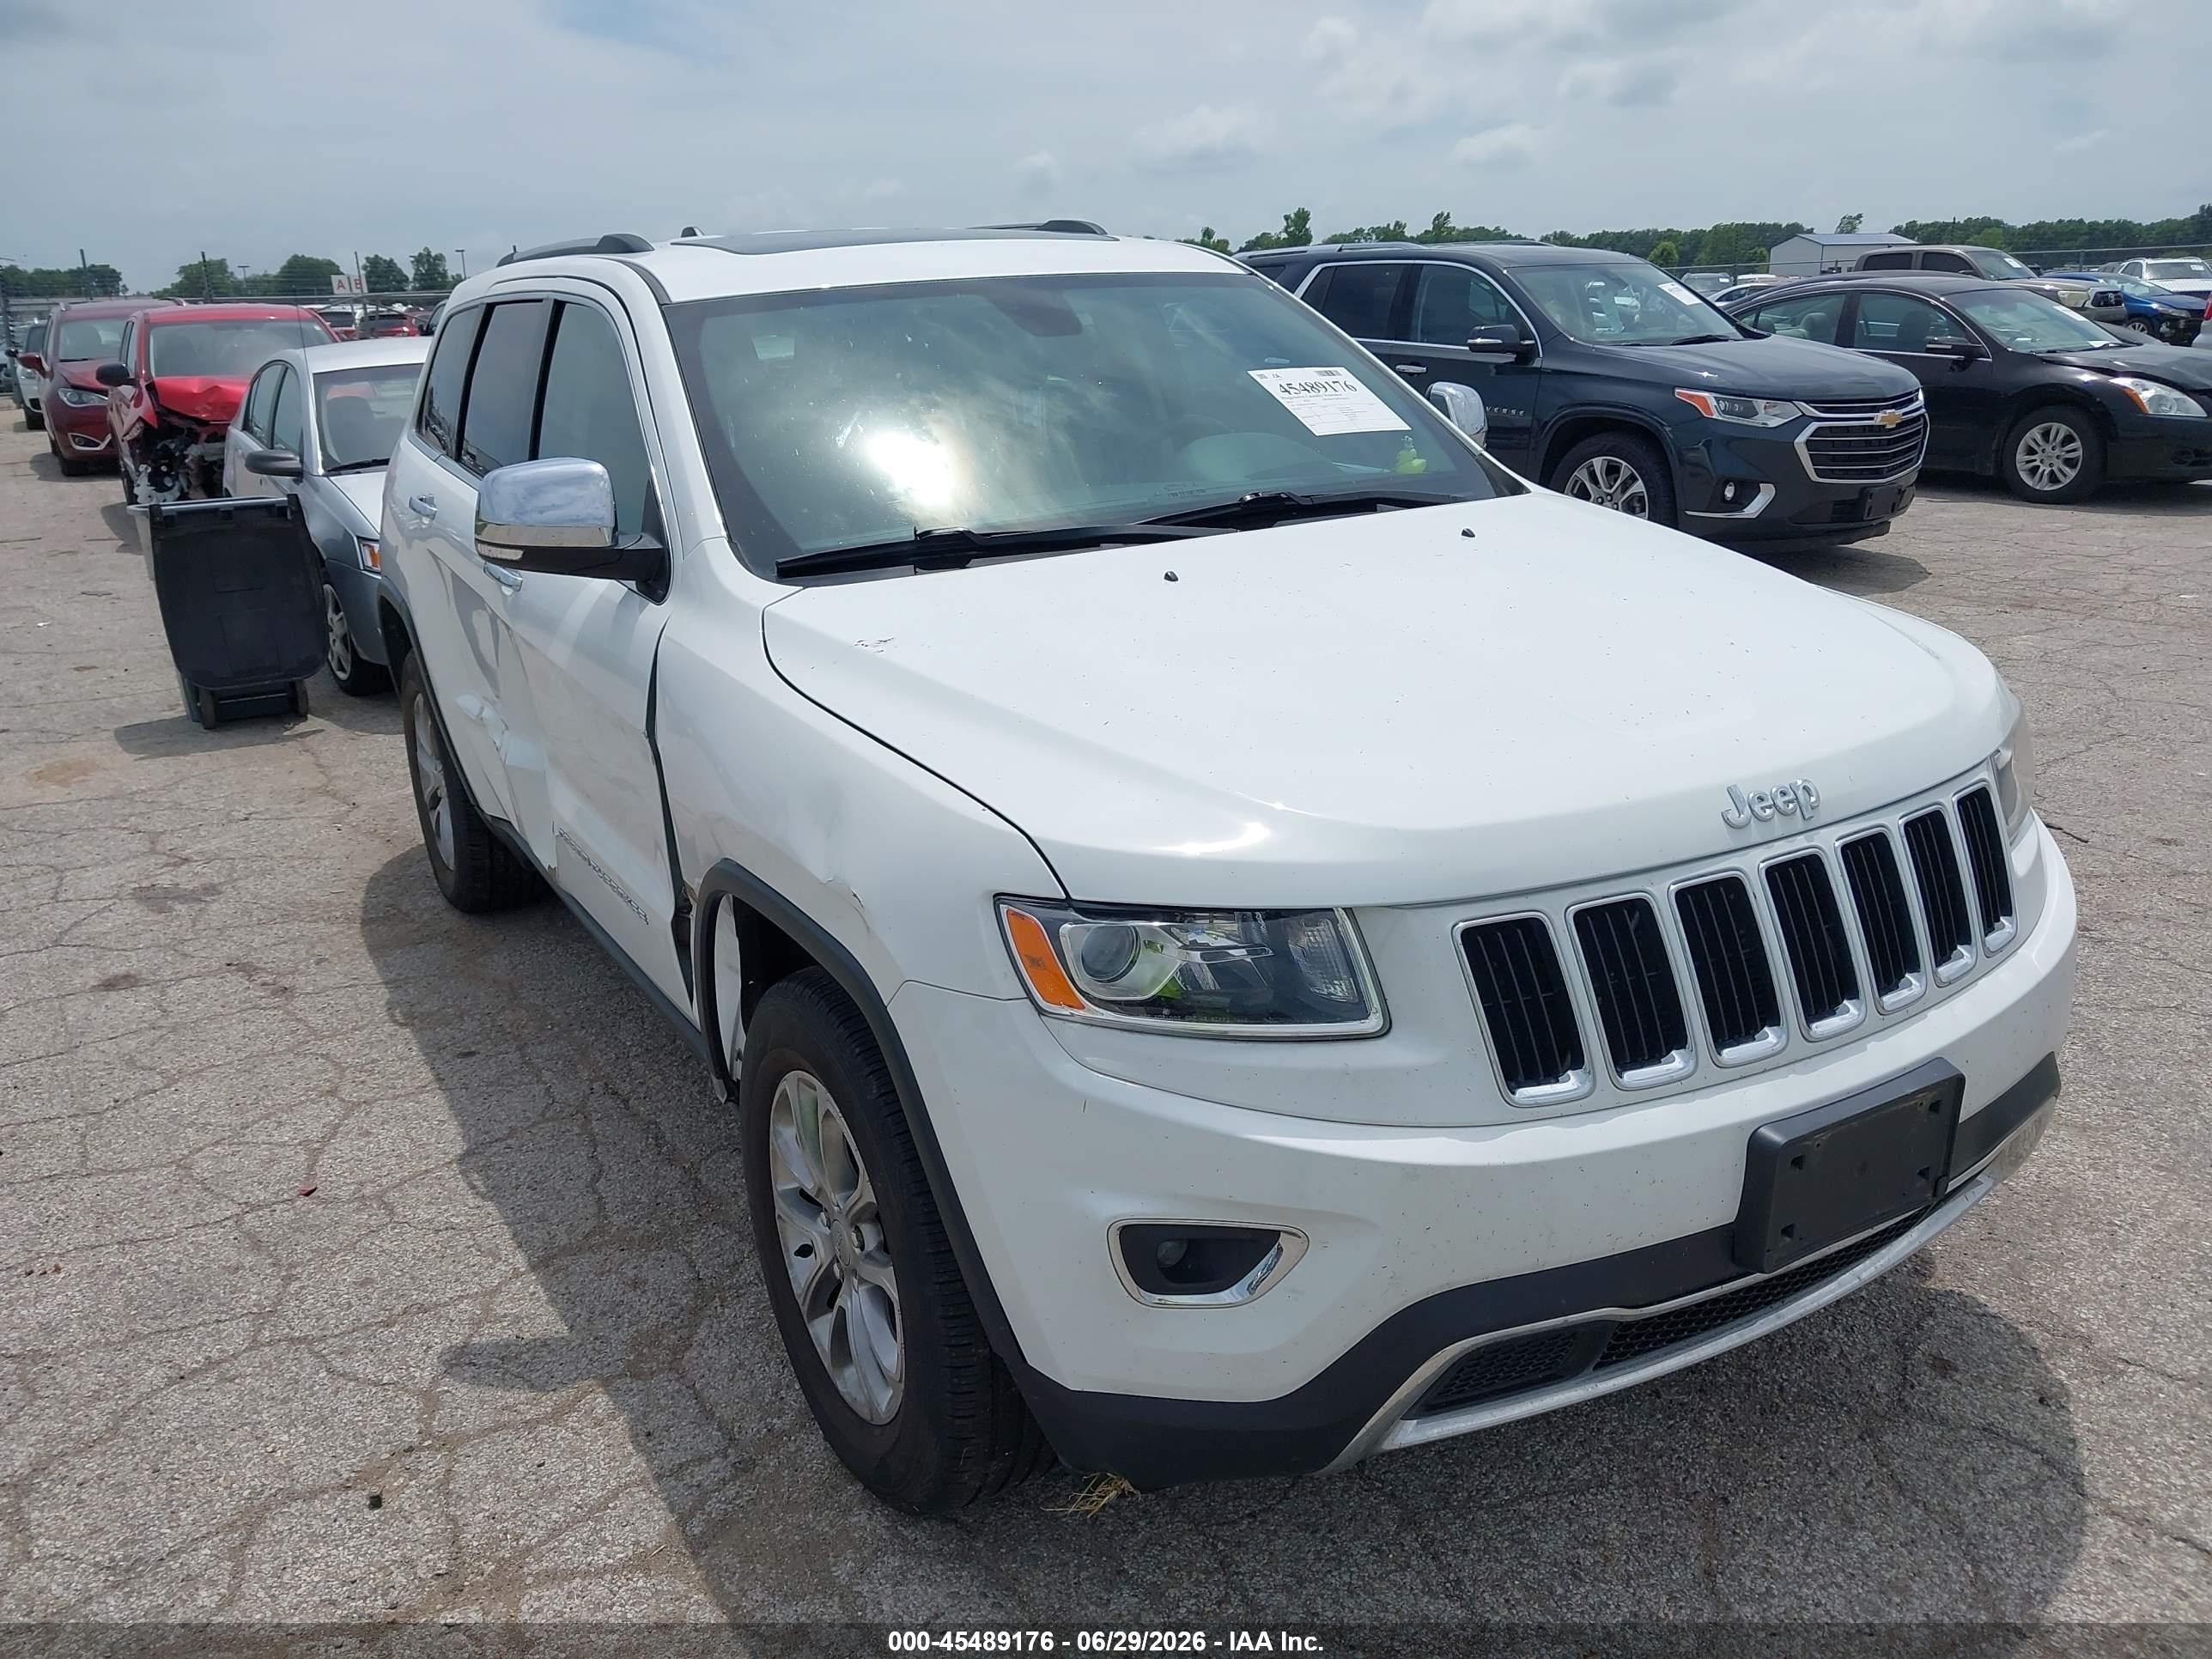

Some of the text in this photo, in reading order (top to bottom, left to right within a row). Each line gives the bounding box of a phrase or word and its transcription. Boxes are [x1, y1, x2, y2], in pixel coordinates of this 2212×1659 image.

[337, 279, 345, 289] A
[1279, 380, 1358, 395] 45489176
[1485, 406, 1525, 416] VERSE
[1720, 777, 1821, 830] Jeep
